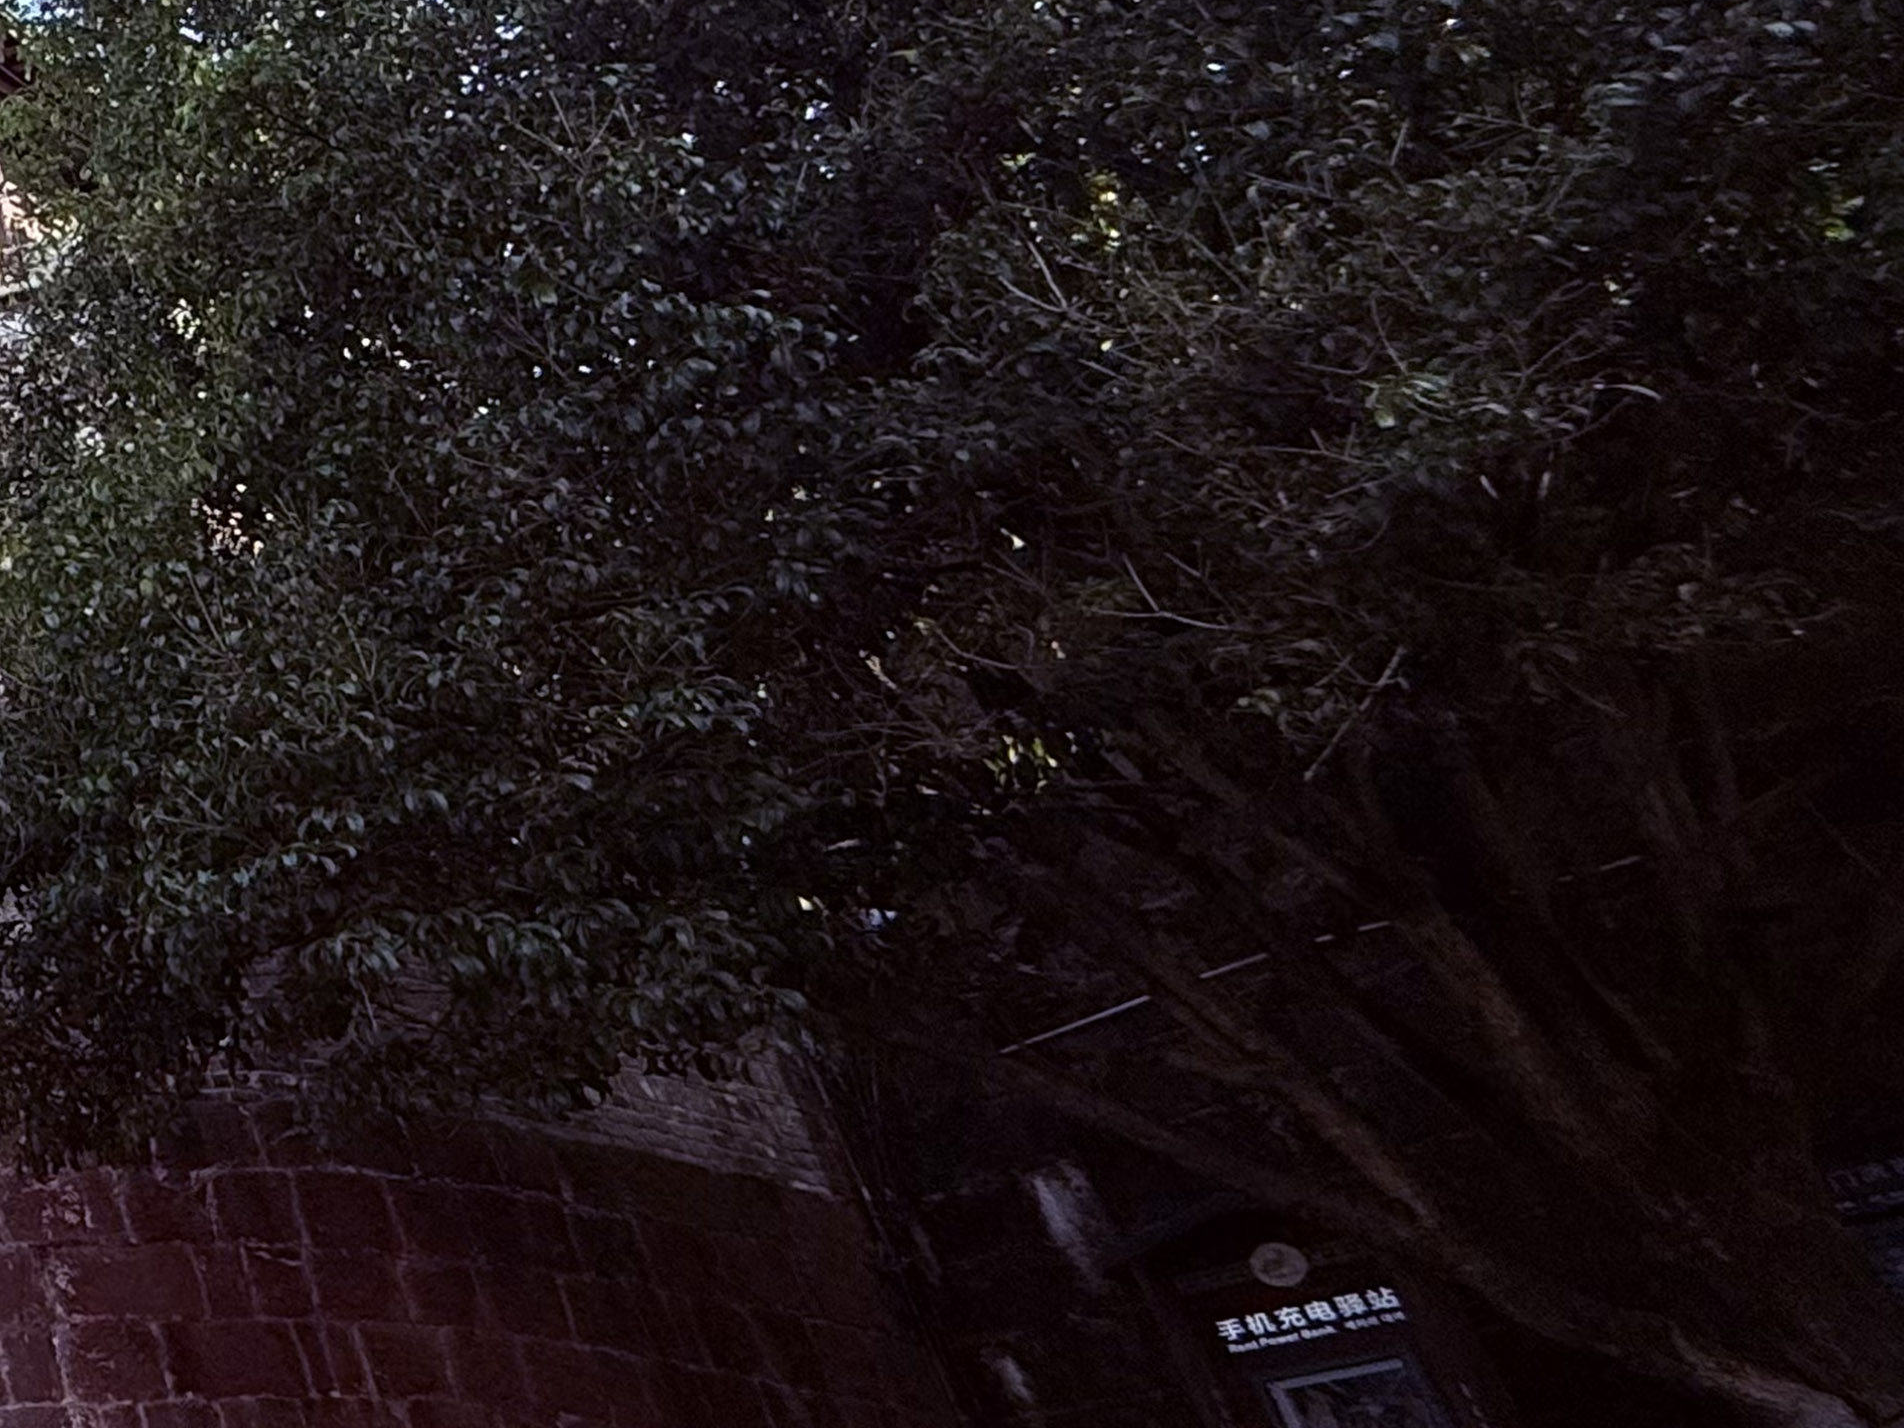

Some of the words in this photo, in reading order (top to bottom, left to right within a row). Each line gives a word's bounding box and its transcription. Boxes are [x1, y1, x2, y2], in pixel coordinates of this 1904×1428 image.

[1215, 1286, 1401, 1341] 手机充电驿站
